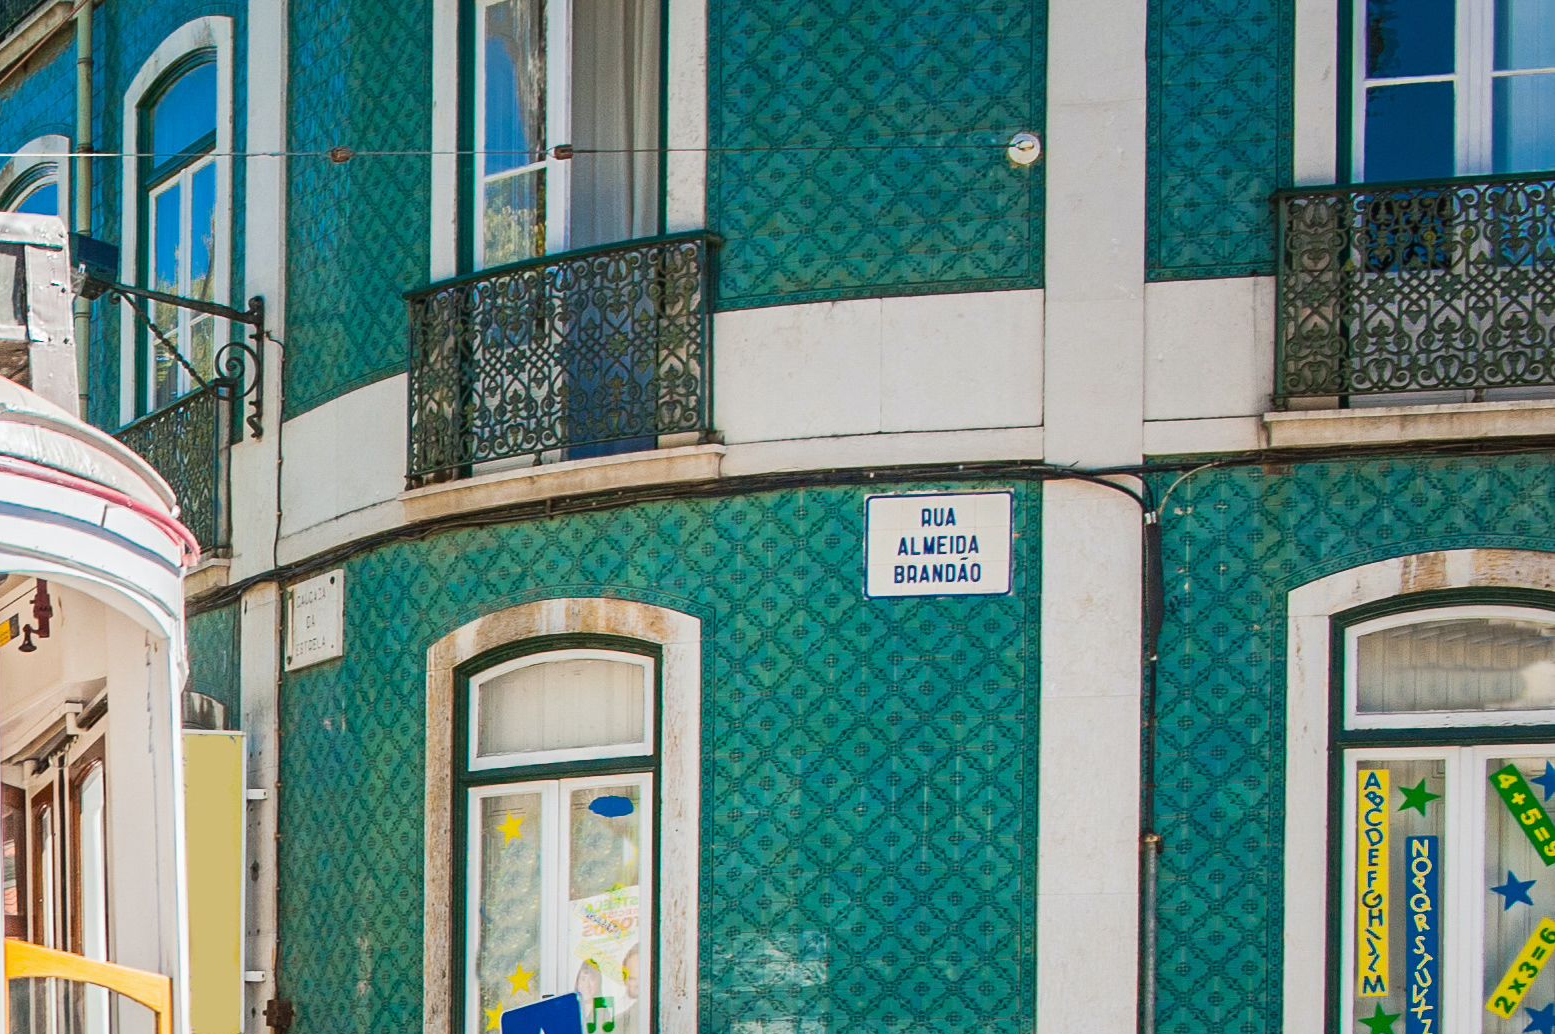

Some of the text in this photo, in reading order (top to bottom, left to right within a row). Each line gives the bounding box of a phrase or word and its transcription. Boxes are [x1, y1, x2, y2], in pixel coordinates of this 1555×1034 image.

[921, 507, 956, 527] RUA
[897, 534, 979, 556] ALMEIDA
[893, 557, 981, 583] BRANDÃO
